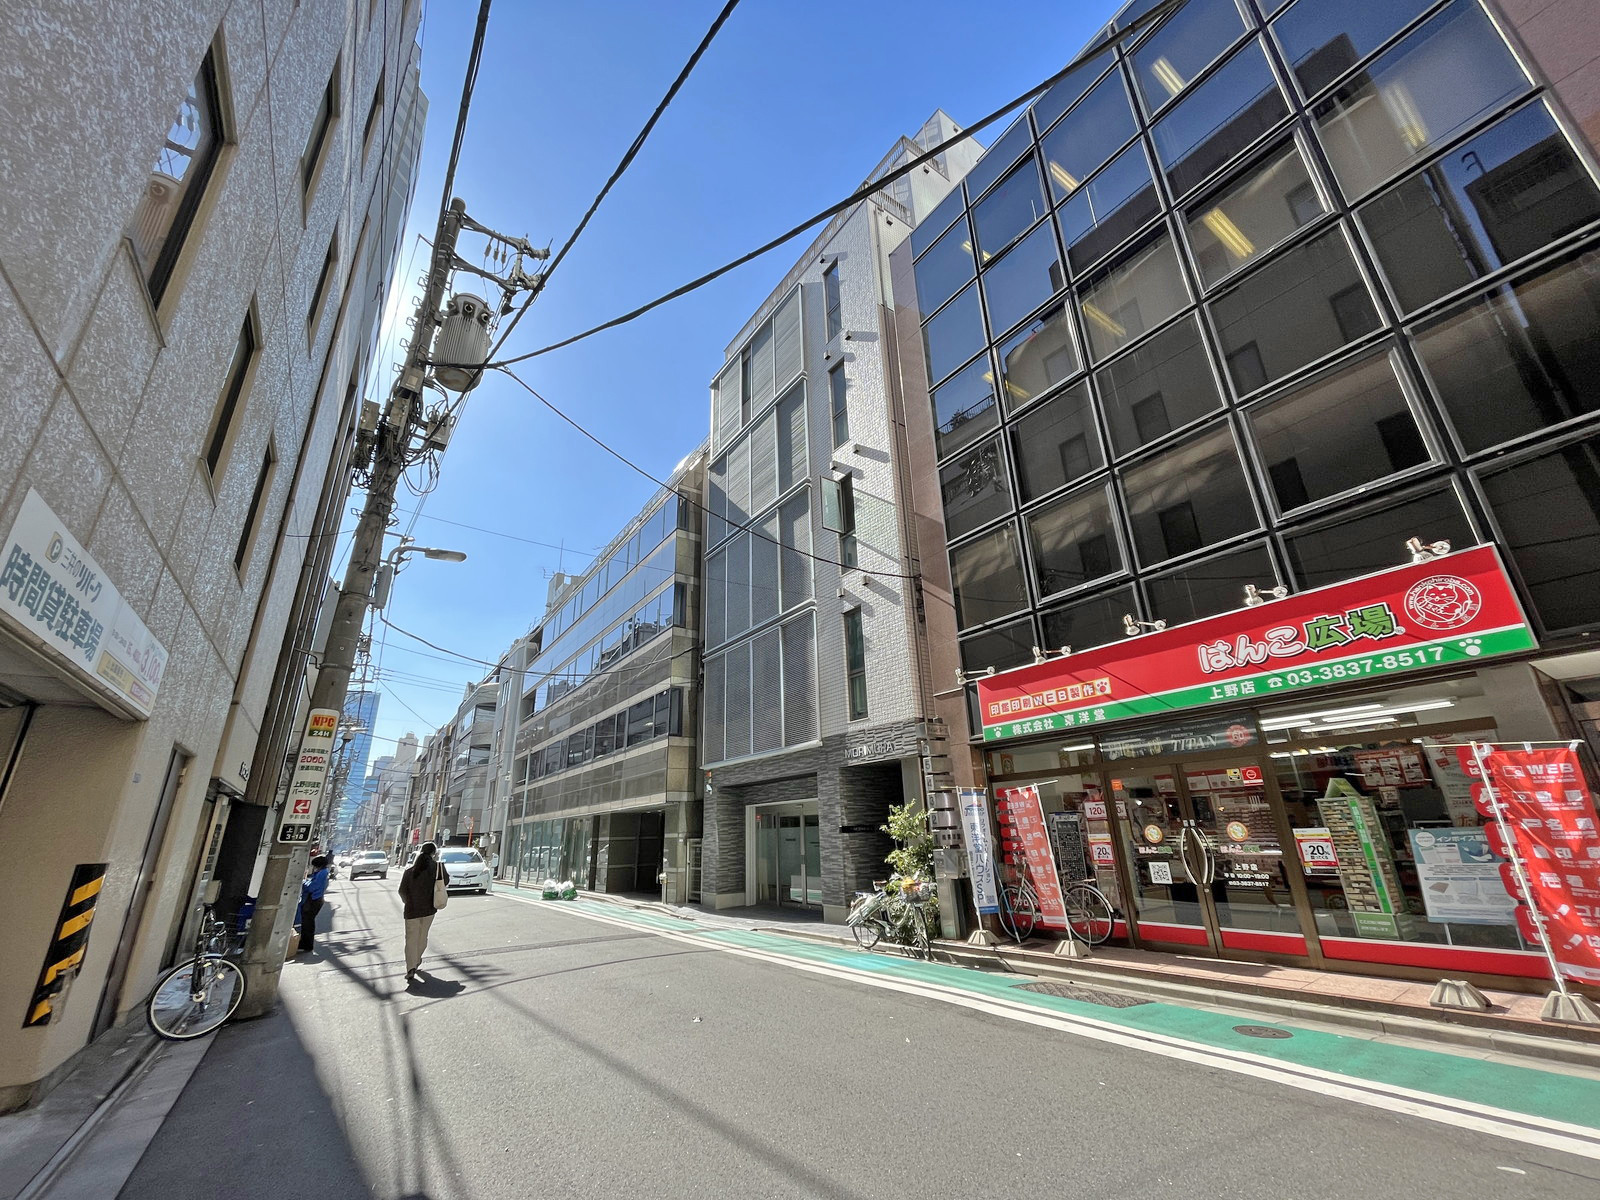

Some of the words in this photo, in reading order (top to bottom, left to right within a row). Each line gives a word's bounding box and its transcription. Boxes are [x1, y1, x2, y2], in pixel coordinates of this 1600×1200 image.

[61, 547, 103, 603] 三井のリパーク
[0, 543, 104, 662] 時間貸駐車場
[1198, 602, 1396, 674] はんこ広場
[1287, 646, 1445, 686] 03-3837-8517
[990, 684, 1094, 716] 印鑑印刷WEB製作
[1210, 681, 1255, 699] 上野店
[312, 716, 335, 728] NPC
[1012, 717, 1054, 736] 株式会社
[1064, 708, 1106, 727] 東洋堂
[1171, 734, 1218, 752] TITAN
[1526, 763, 1574, 775] WEB
[1308, 844, 1331, 856] 20%
